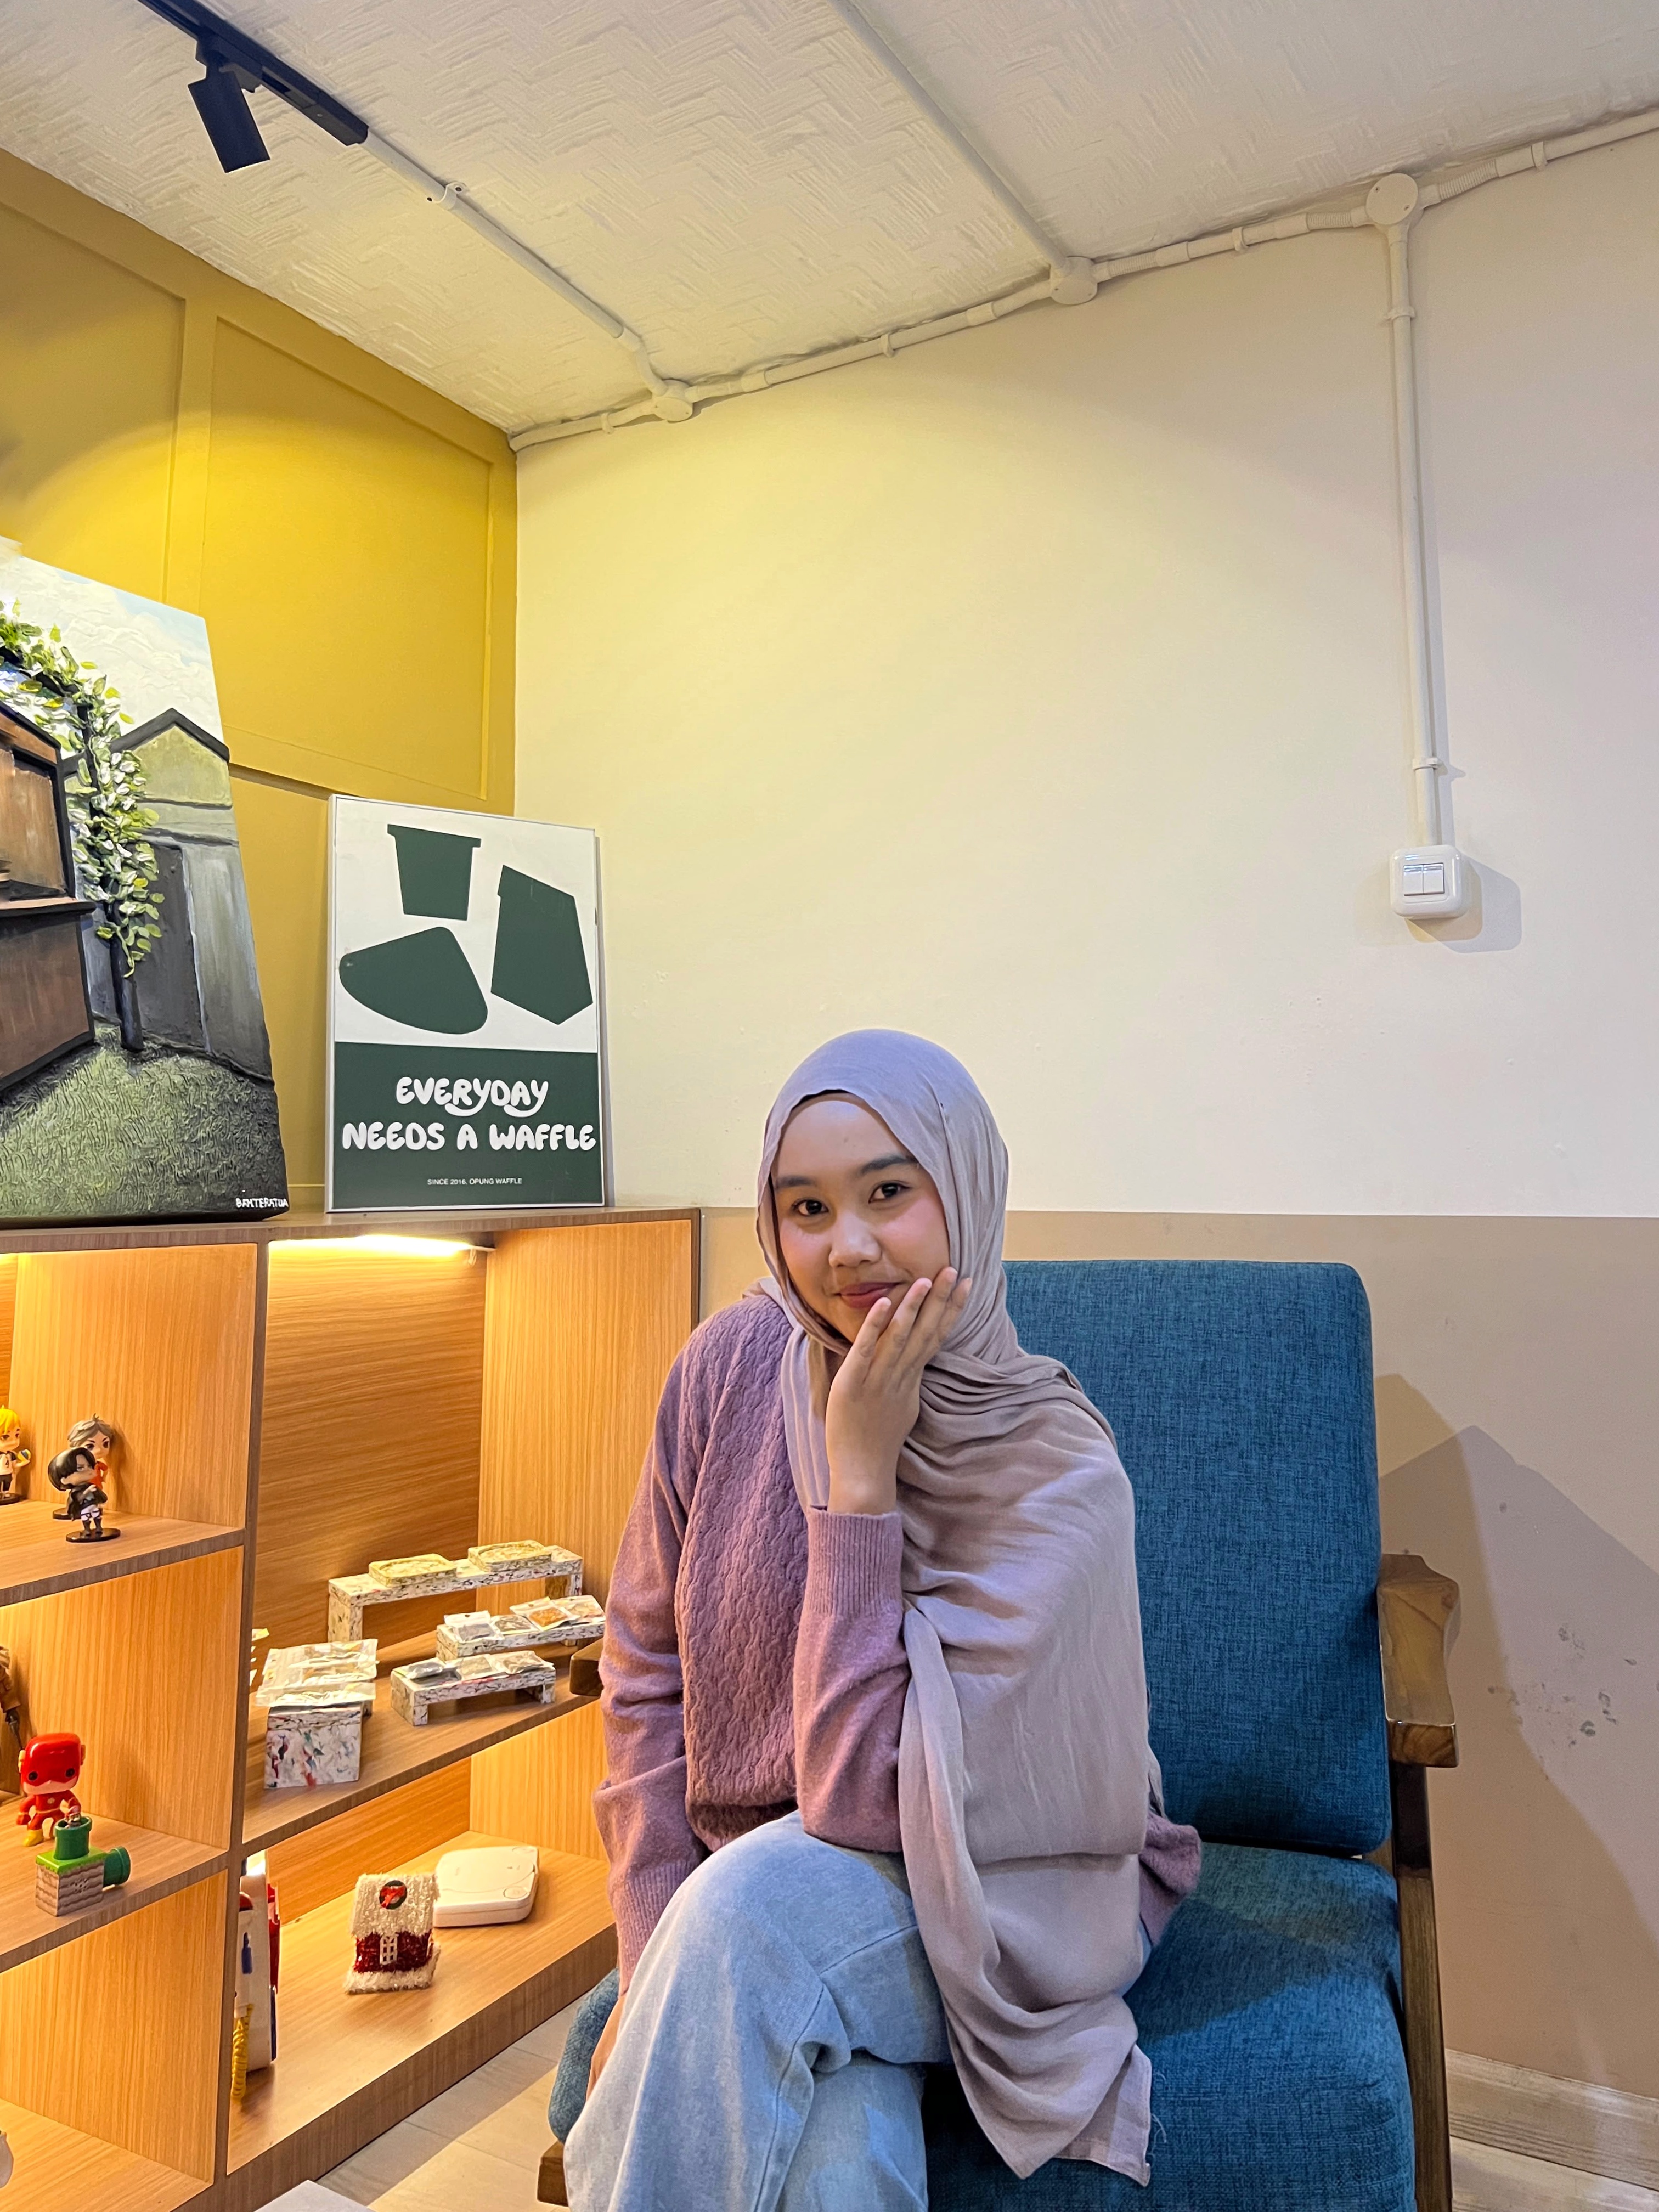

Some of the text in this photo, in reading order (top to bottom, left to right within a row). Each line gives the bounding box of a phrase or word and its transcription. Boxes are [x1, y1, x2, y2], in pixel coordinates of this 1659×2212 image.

[396, 1076, 549, 1118] EVERYDAY
[342, 1121, 596, 1151] NEEDS A WAFFLE
